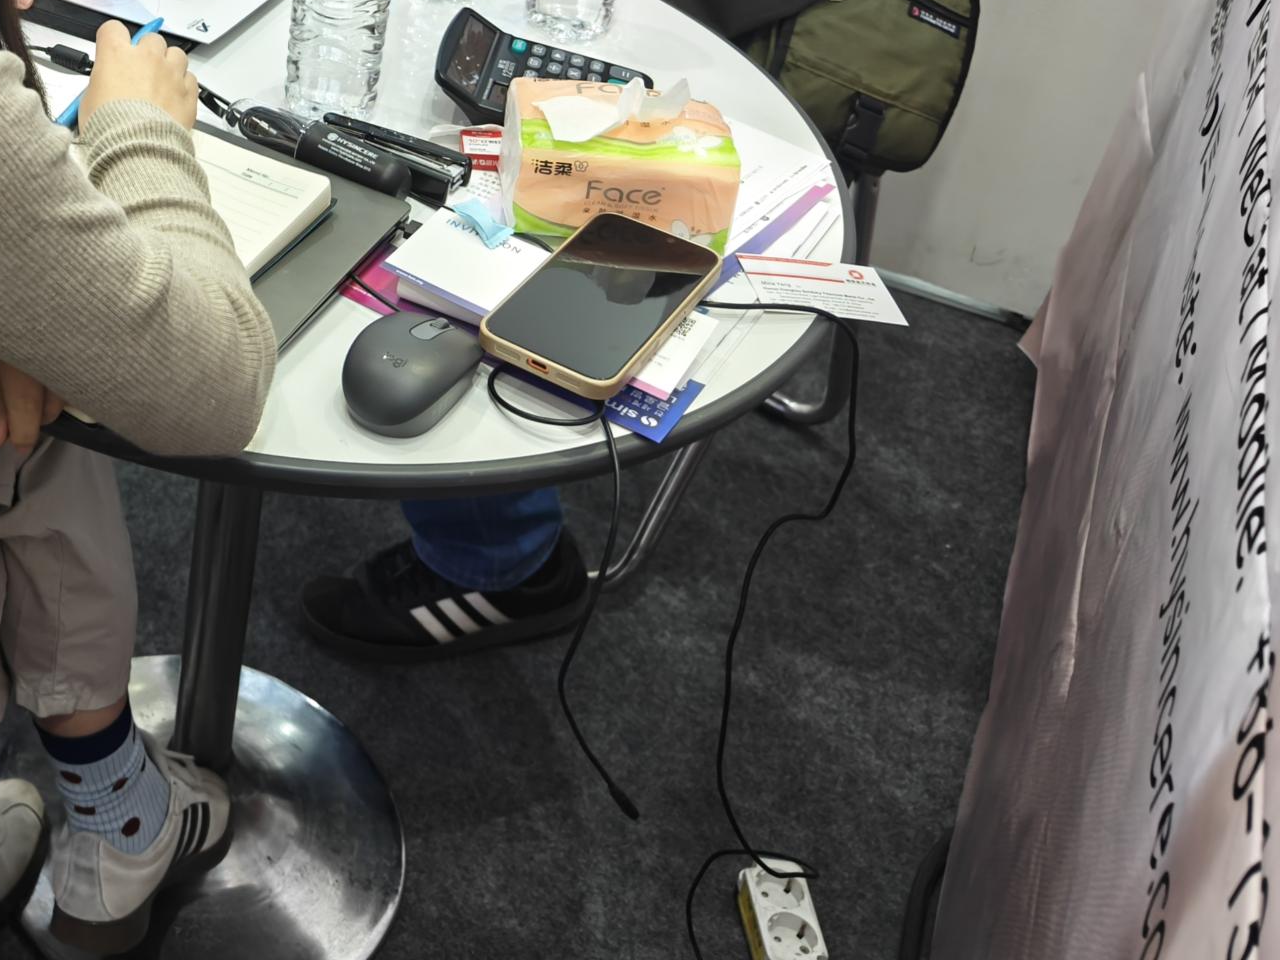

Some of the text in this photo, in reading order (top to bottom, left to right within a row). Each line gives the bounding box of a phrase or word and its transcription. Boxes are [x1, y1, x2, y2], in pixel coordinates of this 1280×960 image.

[533, 159, 573, 177] 洁柔
[585, 180, 663, 206] Face
[1175, 174, 1216, 385] site:
